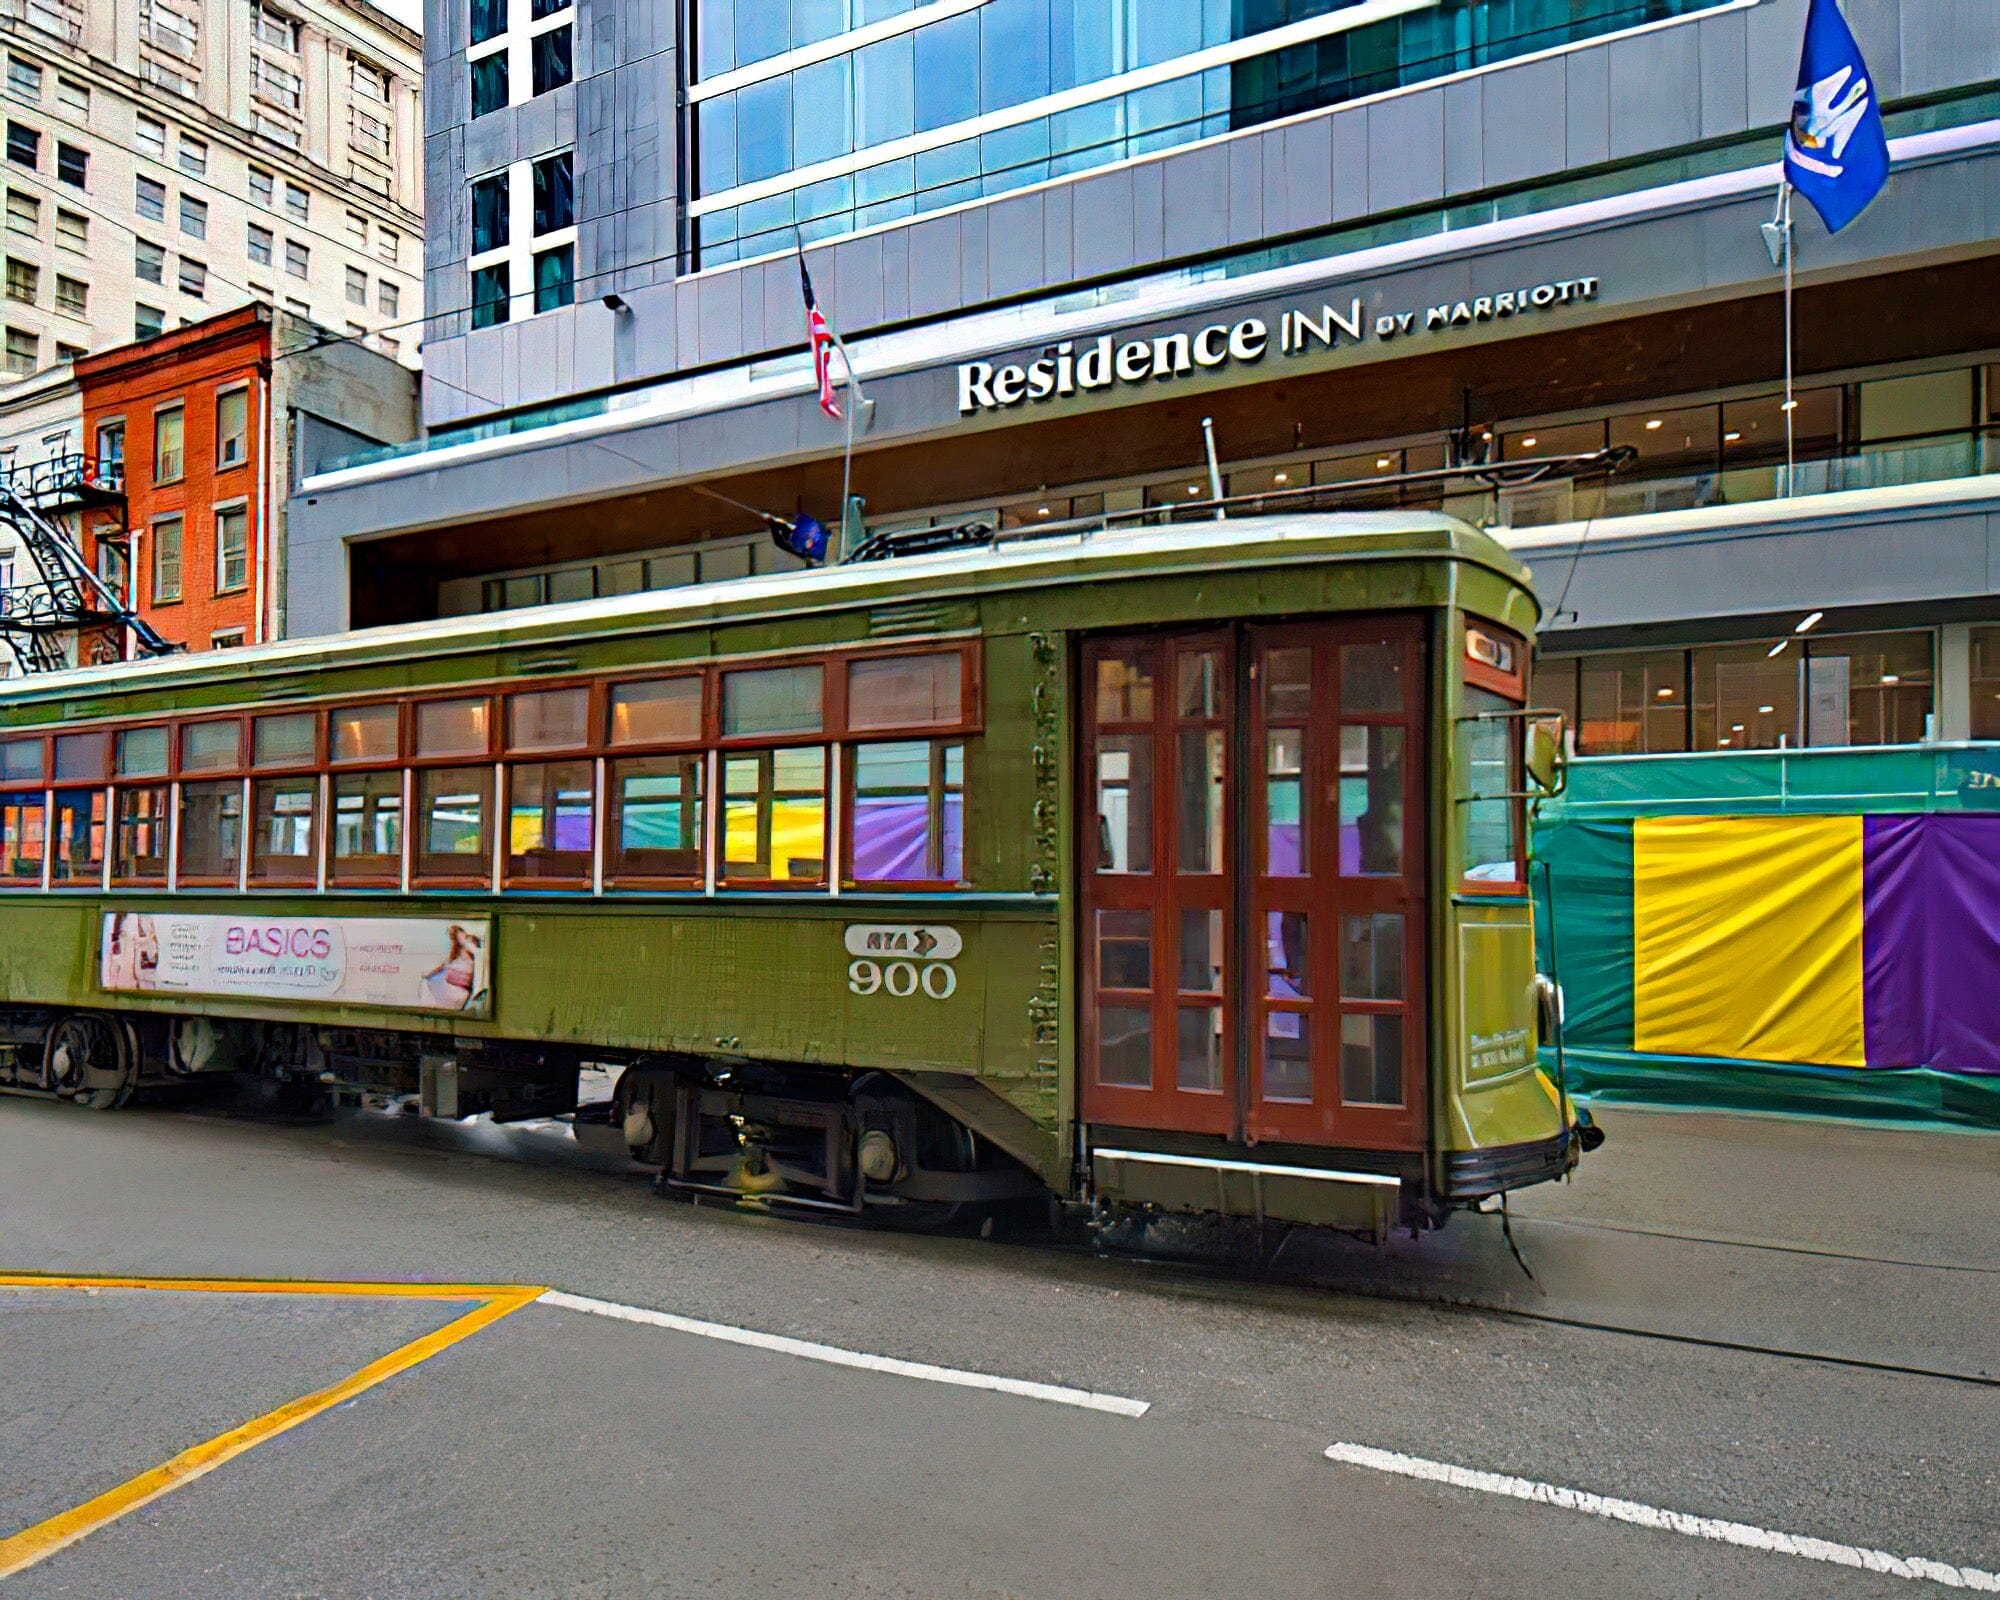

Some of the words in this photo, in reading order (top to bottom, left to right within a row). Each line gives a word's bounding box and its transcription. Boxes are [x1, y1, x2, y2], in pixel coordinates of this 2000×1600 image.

[957, 317, 1268, 412] Residence
[1280, 298, 1361, 354] INN
[1426, 276, 1599, 330] MARRIOTT
[225, 926, 331, 959] BASICS
[848, 959, 957, 1000] 900
